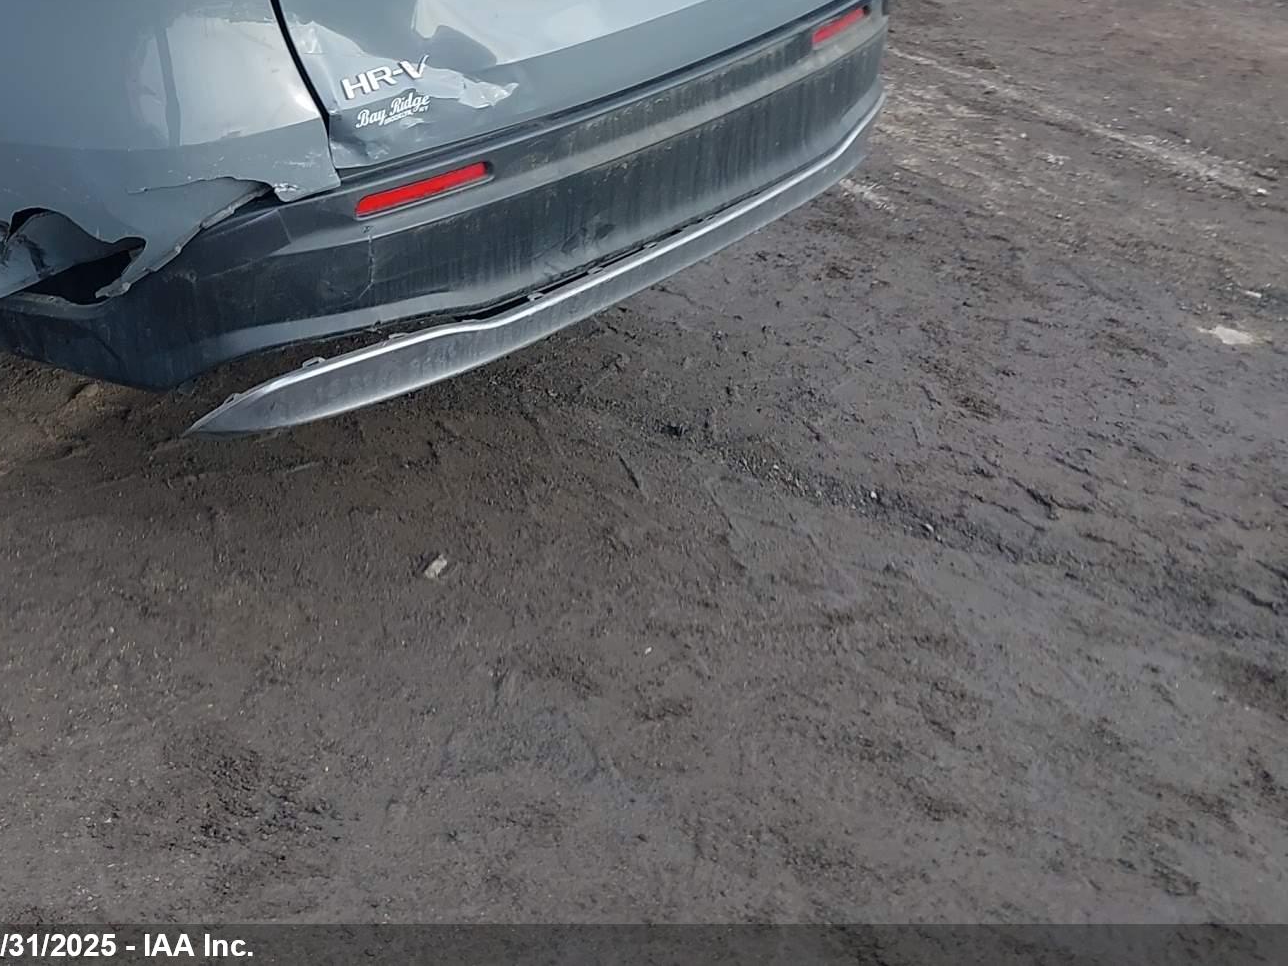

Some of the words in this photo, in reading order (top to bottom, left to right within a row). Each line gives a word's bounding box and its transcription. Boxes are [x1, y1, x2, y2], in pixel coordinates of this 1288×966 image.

[340, 54, 430, 101] HR-V
[355, 108, 387, 129] Bay
[389, 92, 431, 116] Ridge
